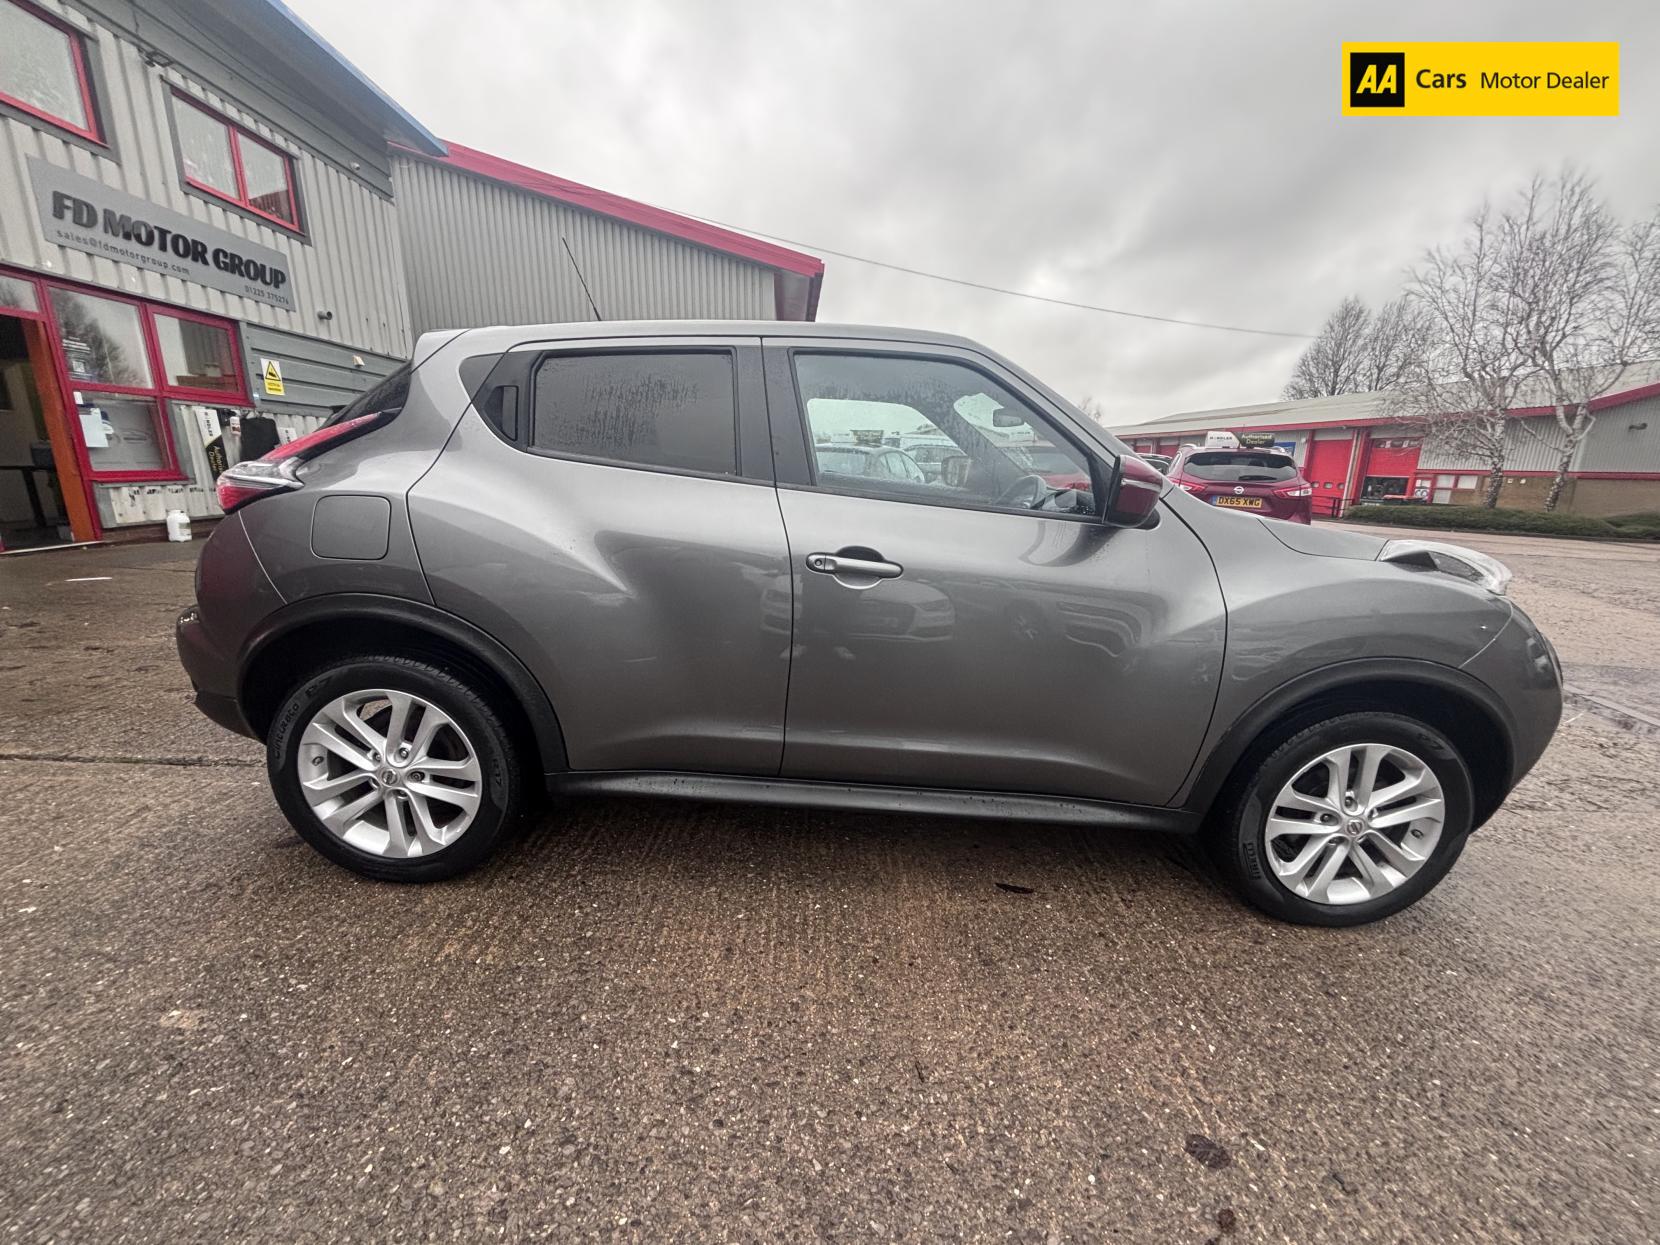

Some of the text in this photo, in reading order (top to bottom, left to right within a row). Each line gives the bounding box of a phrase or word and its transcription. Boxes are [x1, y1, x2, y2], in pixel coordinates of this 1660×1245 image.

[52, 190, 287, 289] FD MOTOR GROUP
[56, 230, 190, 275] sales@fdmotorgroup.com
[244, 285, 265, 297] 01225
[1218, 496, 1260, 507] DX65 XWG
